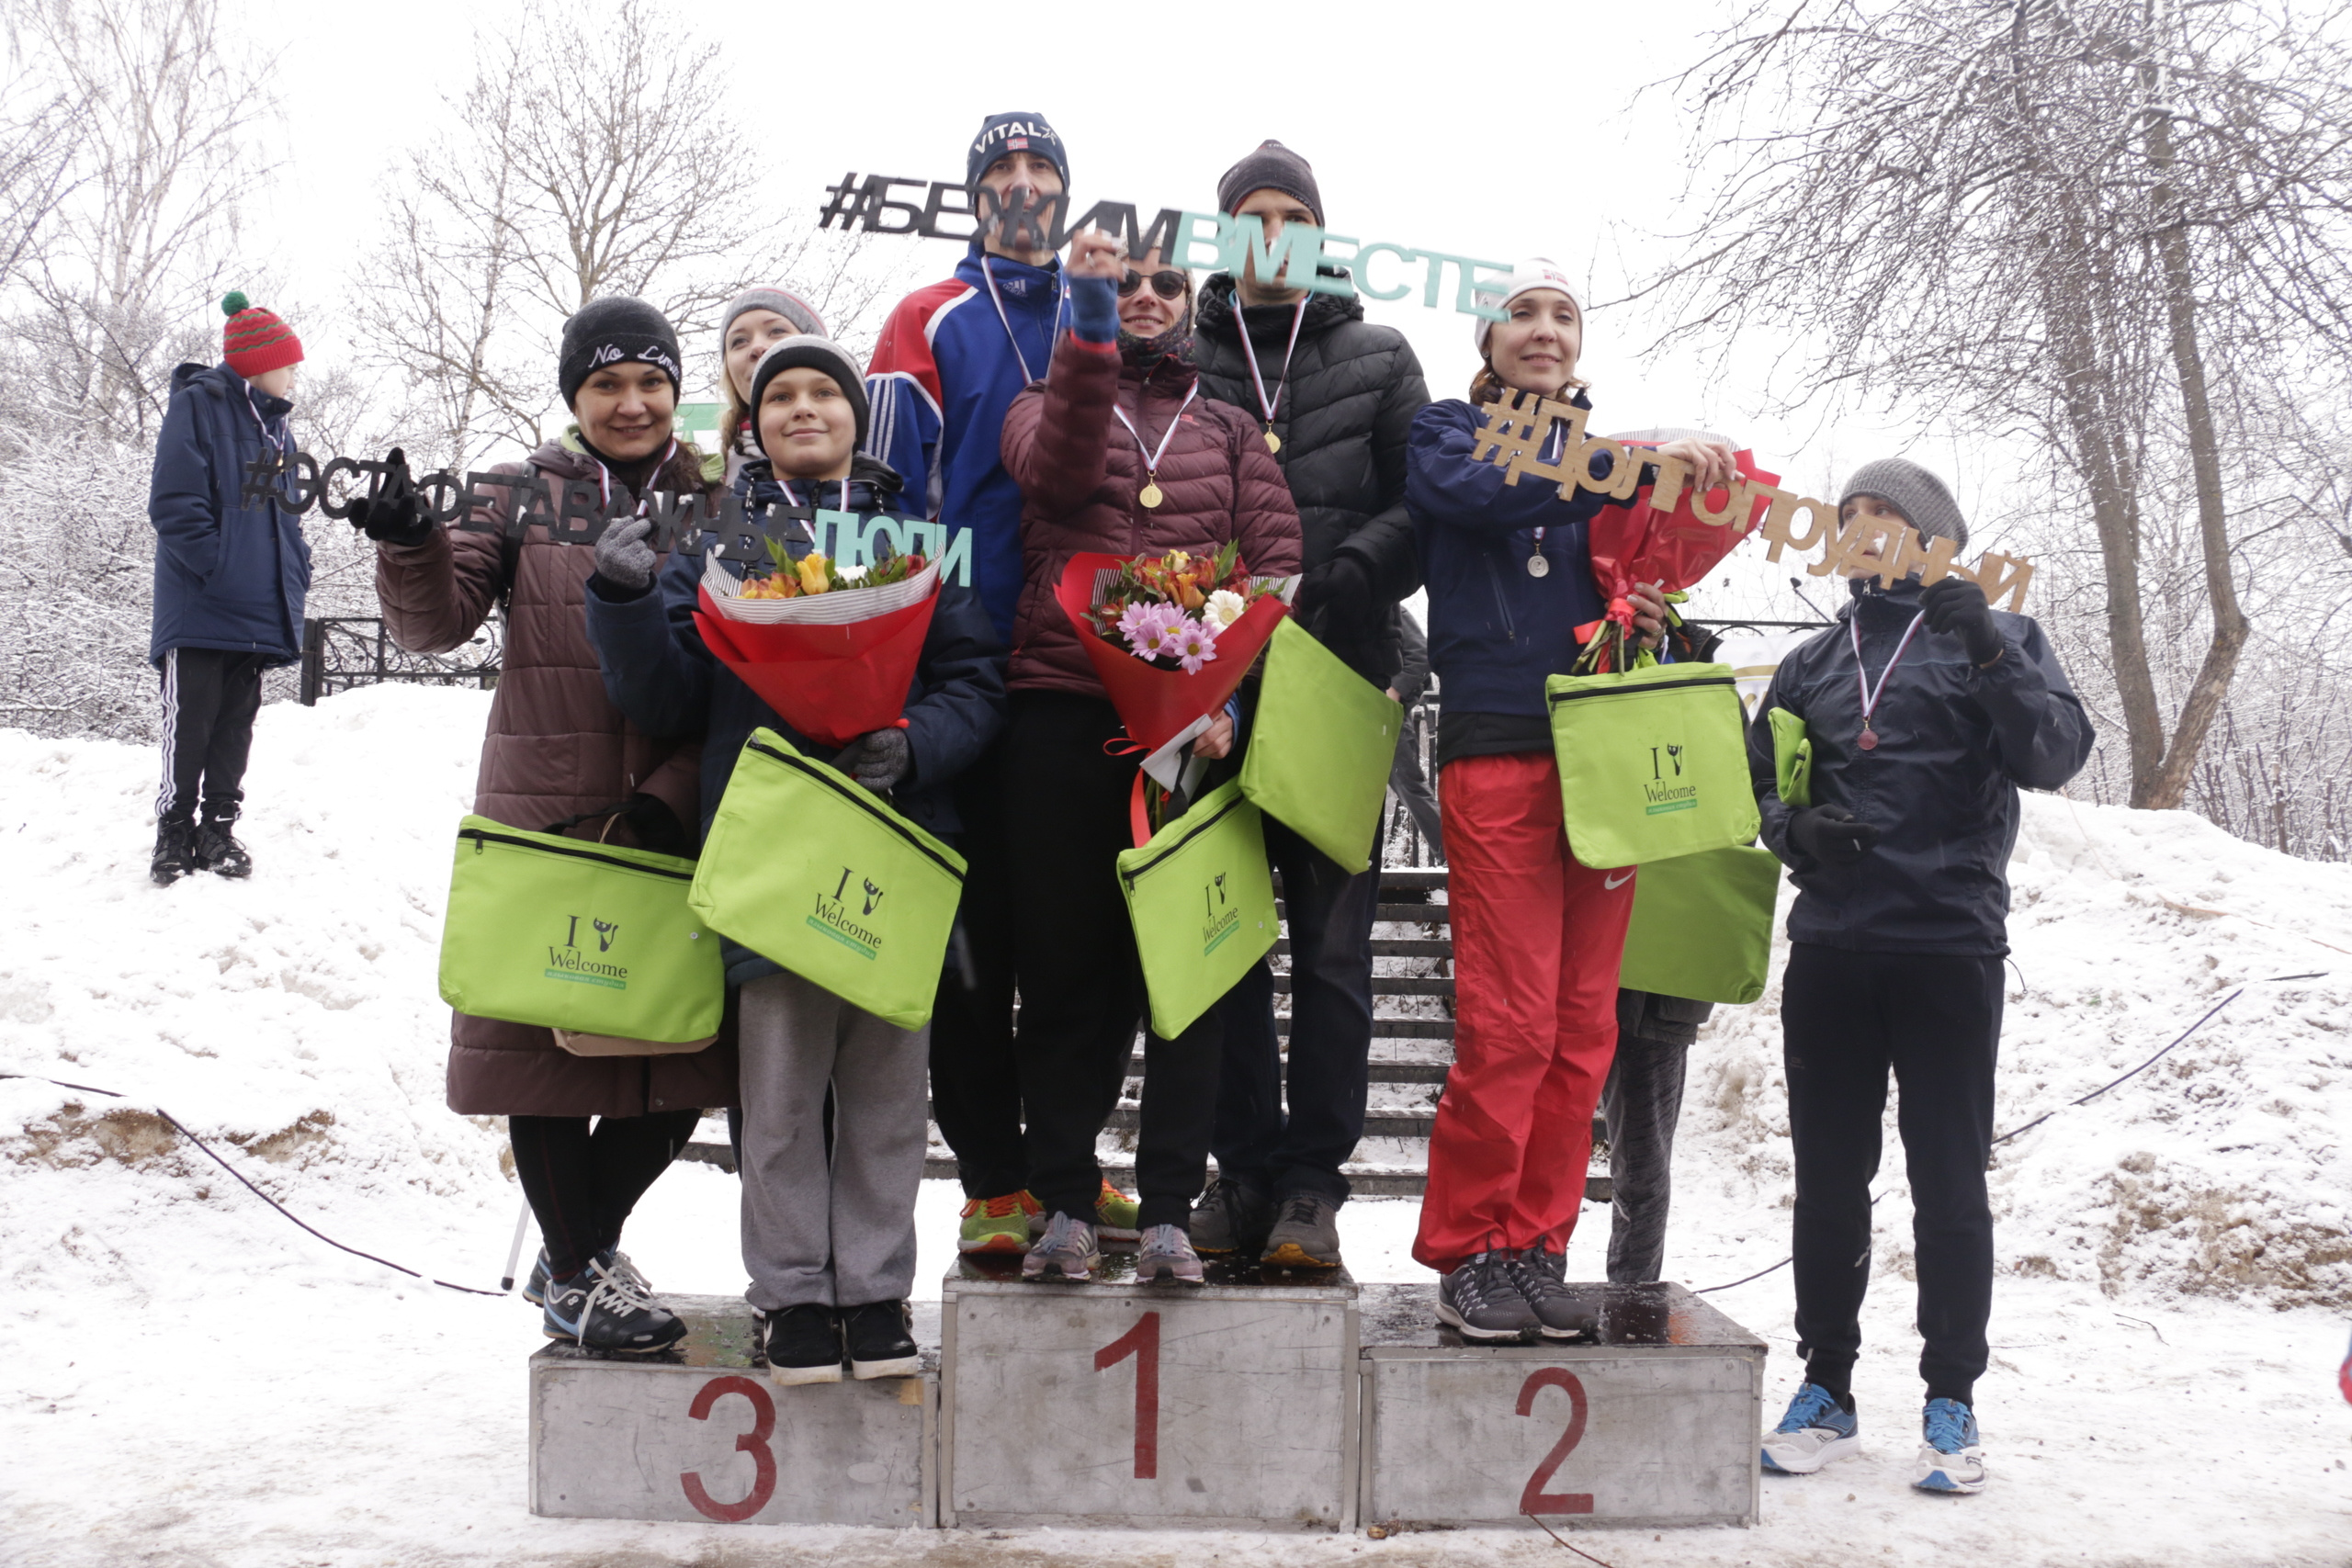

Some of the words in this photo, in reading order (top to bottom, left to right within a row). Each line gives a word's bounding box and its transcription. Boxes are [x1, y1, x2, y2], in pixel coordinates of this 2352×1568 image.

[588, 344, 625, 368] No
[1650, 747, 1662, 780] I
[1643, 781, 1697, 804] Welcome
[831, 866, 854, 903] I
[1204, 884, 1213, 919] I
[563, 915, 581, 948] I
[814, 892, 882, 949] Welcome
[1202, 908, 1238, 943] Welcome
[548, 946, 628, 978] Welcome
[1094, 1311, 1159, 1479] 1
[680, 1375, 776, 1522] 3
[1515, 1367, 1594, 1516] 2
